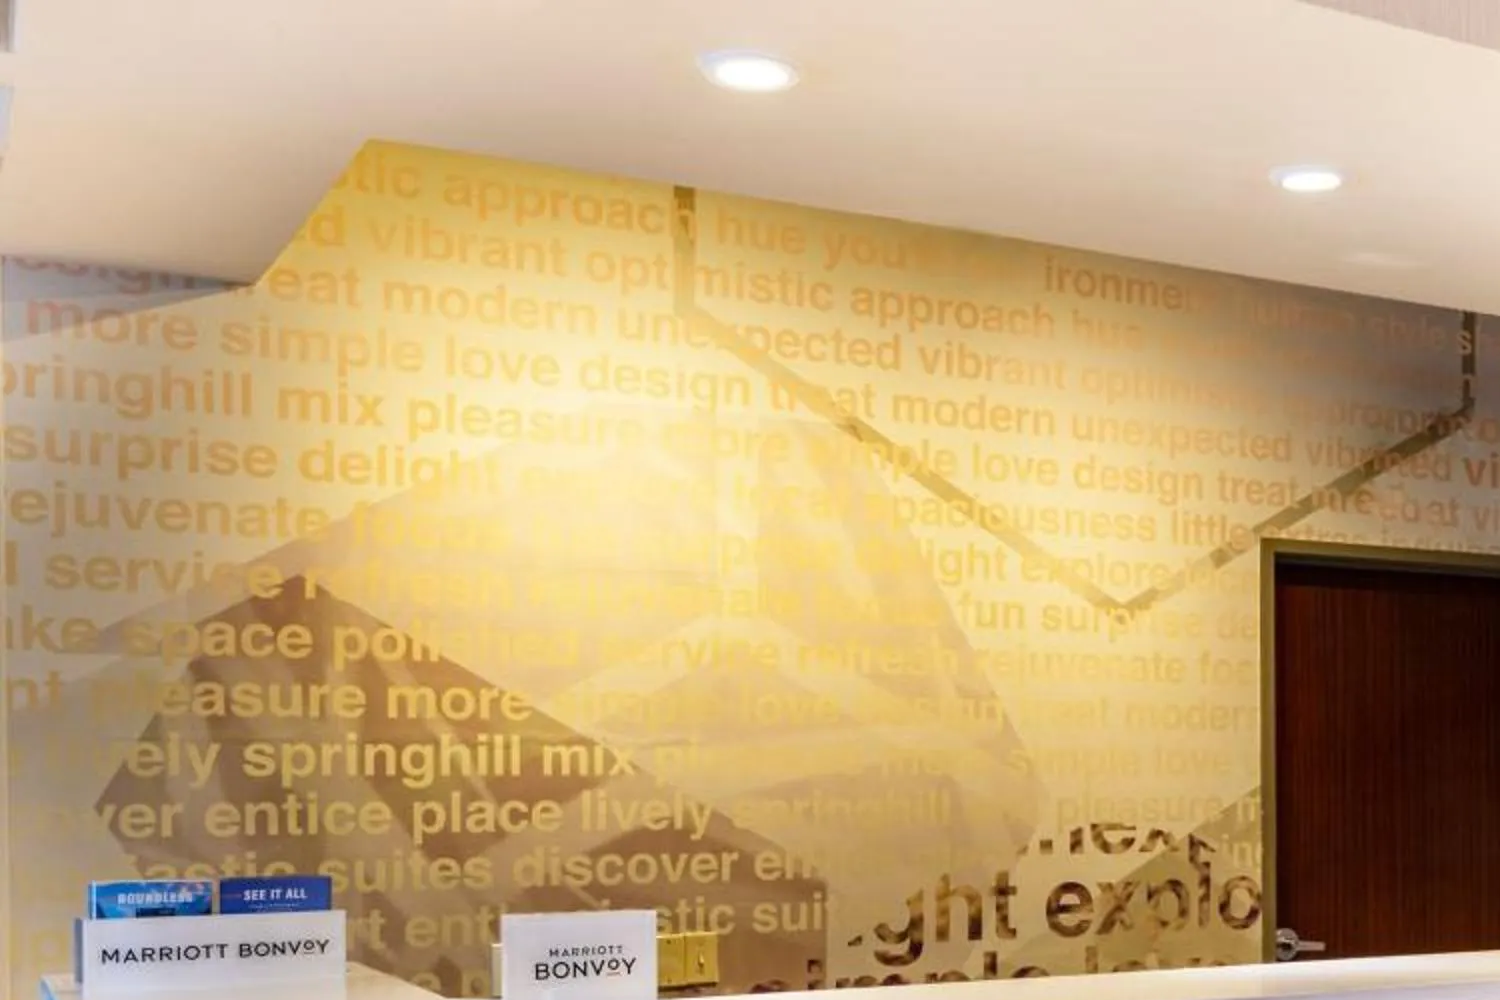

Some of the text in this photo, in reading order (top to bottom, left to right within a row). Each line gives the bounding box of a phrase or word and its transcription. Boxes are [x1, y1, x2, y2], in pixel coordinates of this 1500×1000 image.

[335, 151, 422, 199] tic
[716, 206, 807, 254] hue
[367, 213, 569, 277] vibrant
[585, 249, 834, 312] optmistic
[850, 283, 1055, 341] approach
[383, 280, 597, 336] modern
[917, 341, 1066, 391] vibrant
[26, 298, 198, 352] more
[220, 316, 424, 378] simple
[445, 334, 562, 387] love
[579, 354, 751, 412] design
[891, 384, 1057, 437] modern
[1071, 414, 1292, 463] unexpected
[3, 422, 277, 480] surprise
[275, 380, 384, 428] mix
[406, 393, 643, 447] pleasure
[973, 441, 1060, 487] love
[1073, 454, 1202, 503] design
[2, 484, 328, 541] ejuvenate
[45, 550, 282, 598] service
[957, 591, 1025, 631] fun
[119, 618, 313, 668] space
[387, 686, 532, 721] more
[242, 733, 519, 789] springhill
[543, 735, 635, 778] mix
[204, 793, 392, 839] entice
[411, 791, 563, 852] place
[579, 789, 714, 840] lively
[243, 888, 308, 901] SEE IT ALL
[317, 848, 493, 894] suites
[512, 845, 738, 888] discover
[848, 870, 1018, 966] ght
[100, 939, 331, 965] MARRIOTT BONVOY
[535, 957, 637, 981] BONVOY
[549, 945, 623, 958] MARRIOTT
